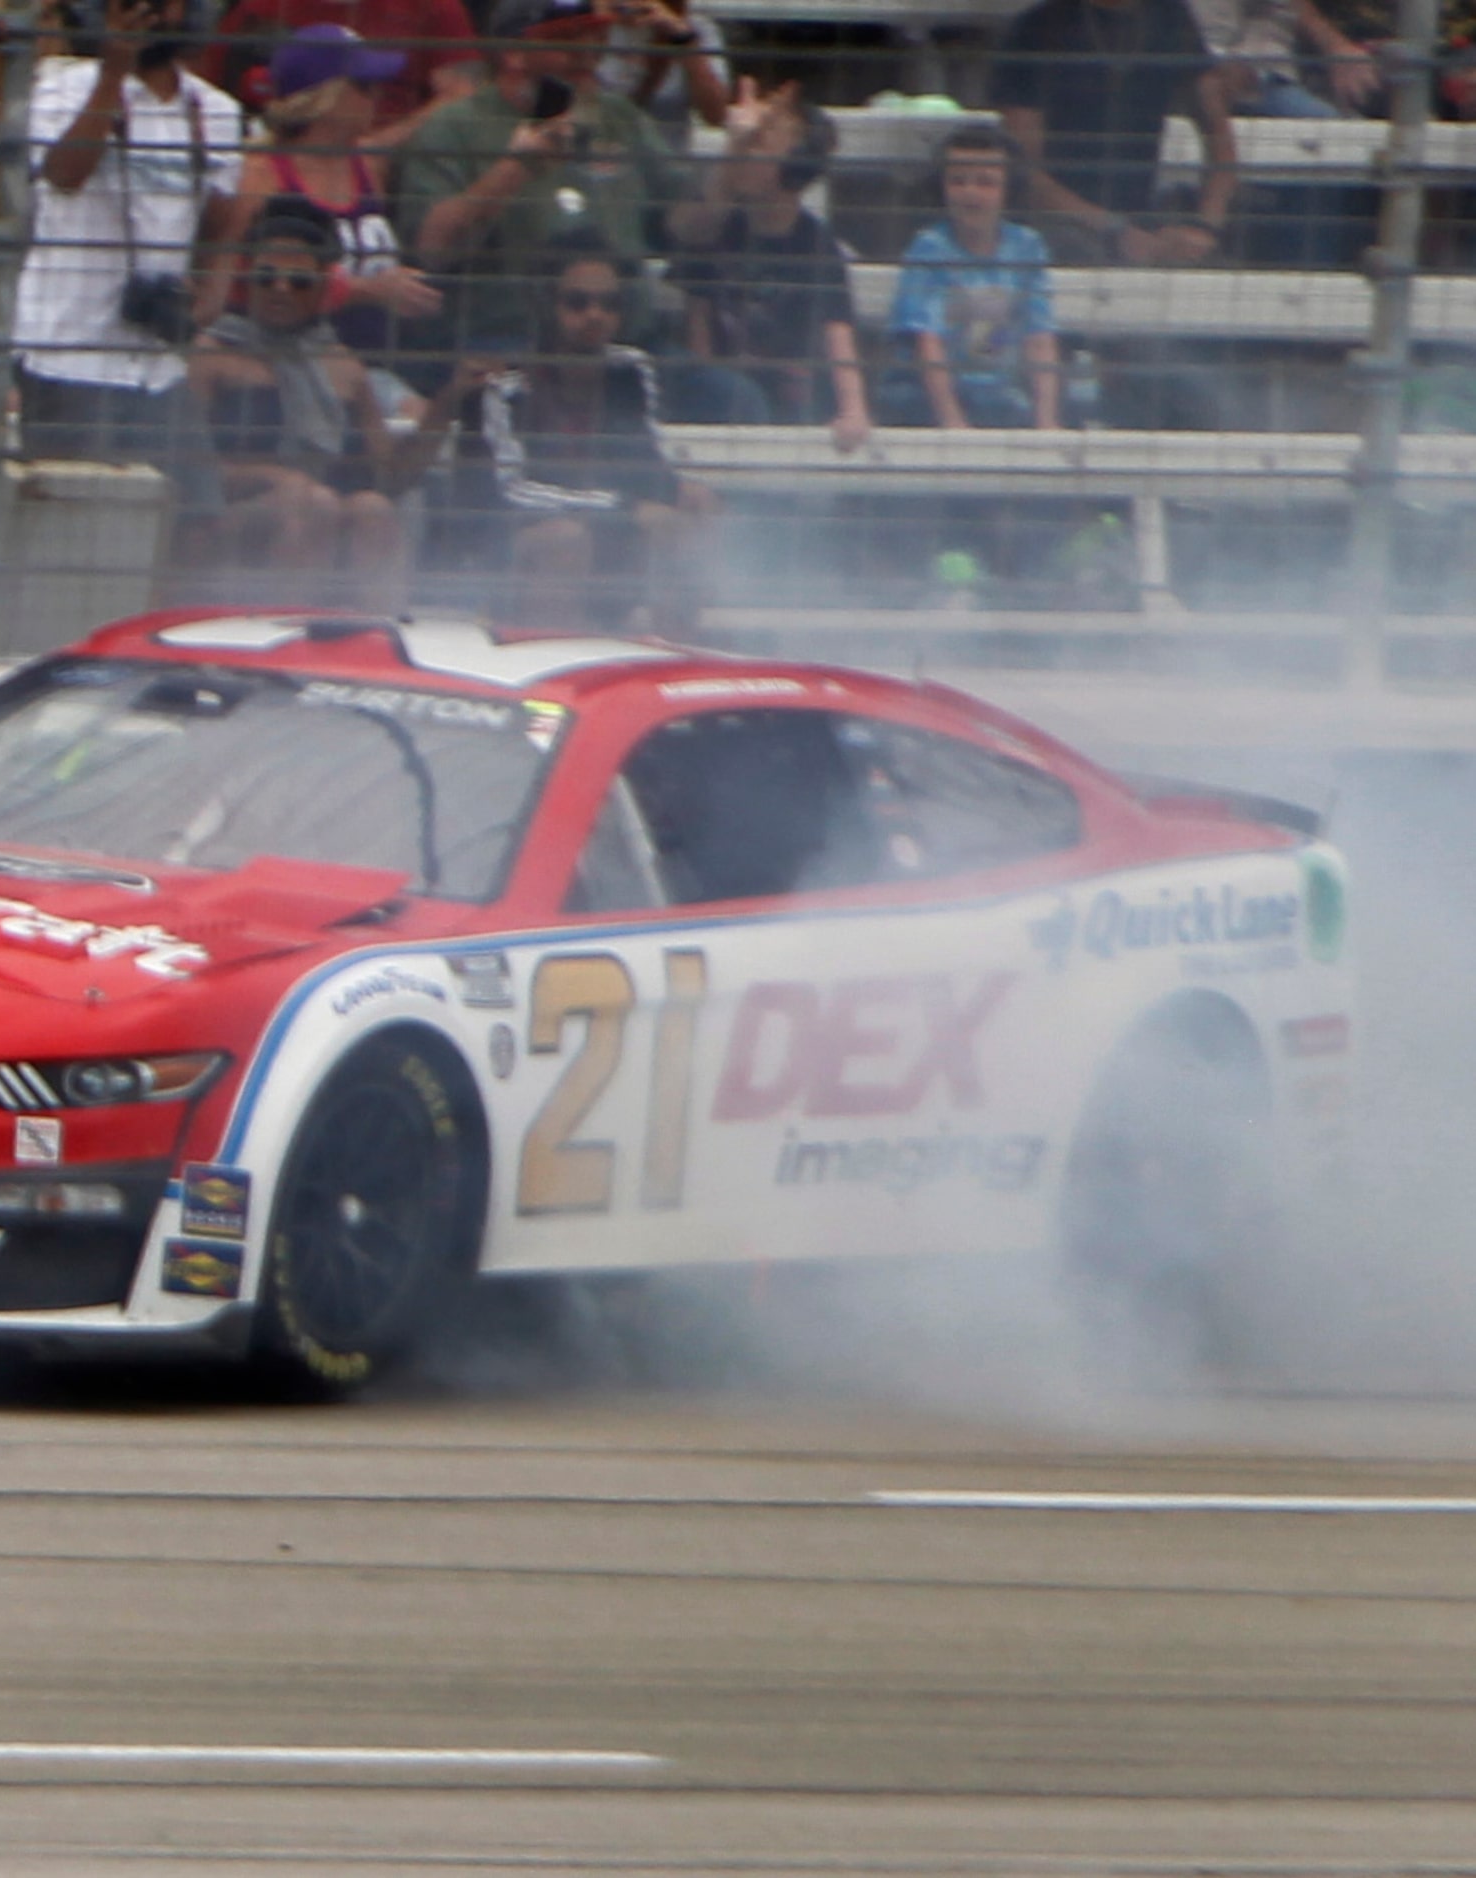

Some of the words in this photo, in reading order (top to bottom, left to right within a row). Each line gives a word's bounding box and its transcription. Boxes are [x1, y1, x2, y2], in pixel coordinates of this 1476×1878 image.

[1082, 884, 1215, 960] Quick
[515, 945, 712, 1219] 21
[709, 968, 1027, 1124] DEX
[775, 1126, 1050, 1197] imaging
